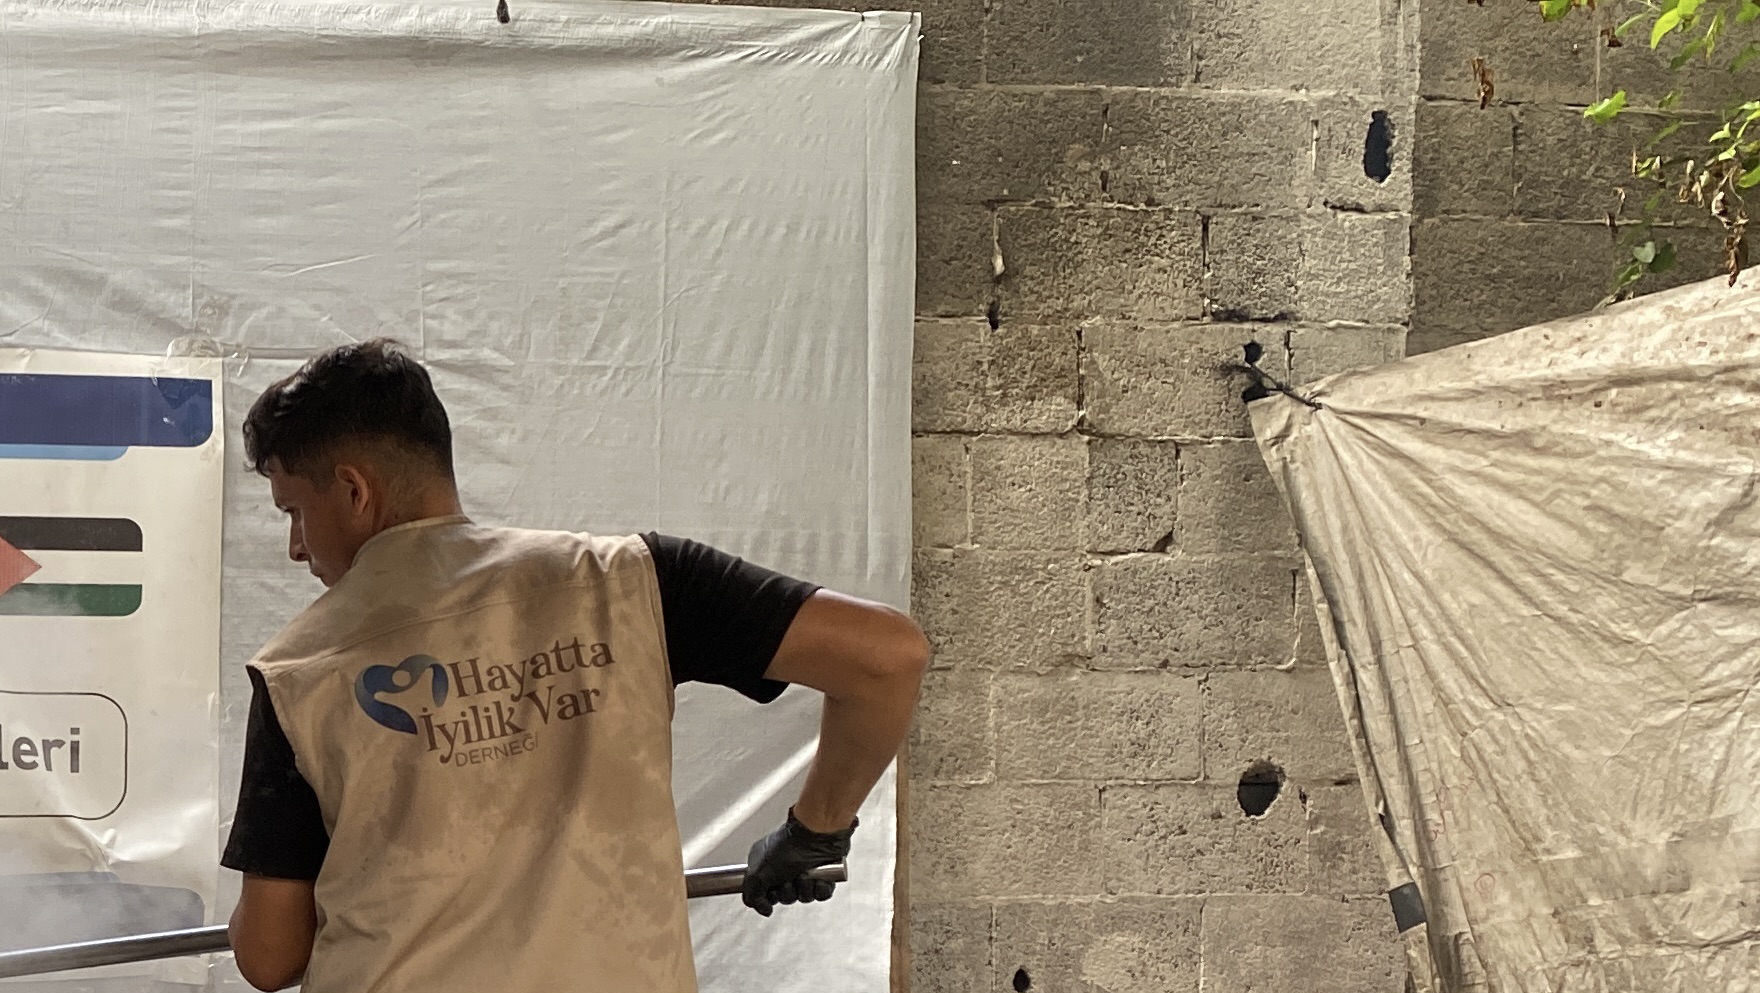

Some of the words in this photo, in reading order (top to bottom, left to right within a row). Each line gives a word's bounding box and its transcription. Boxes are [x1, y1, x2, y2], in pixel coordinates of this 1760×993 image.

[447, 636, 615, 702] Hayatta
[419, 700, 525, 764] İyilik
[526, 684, 601, 726] Var
